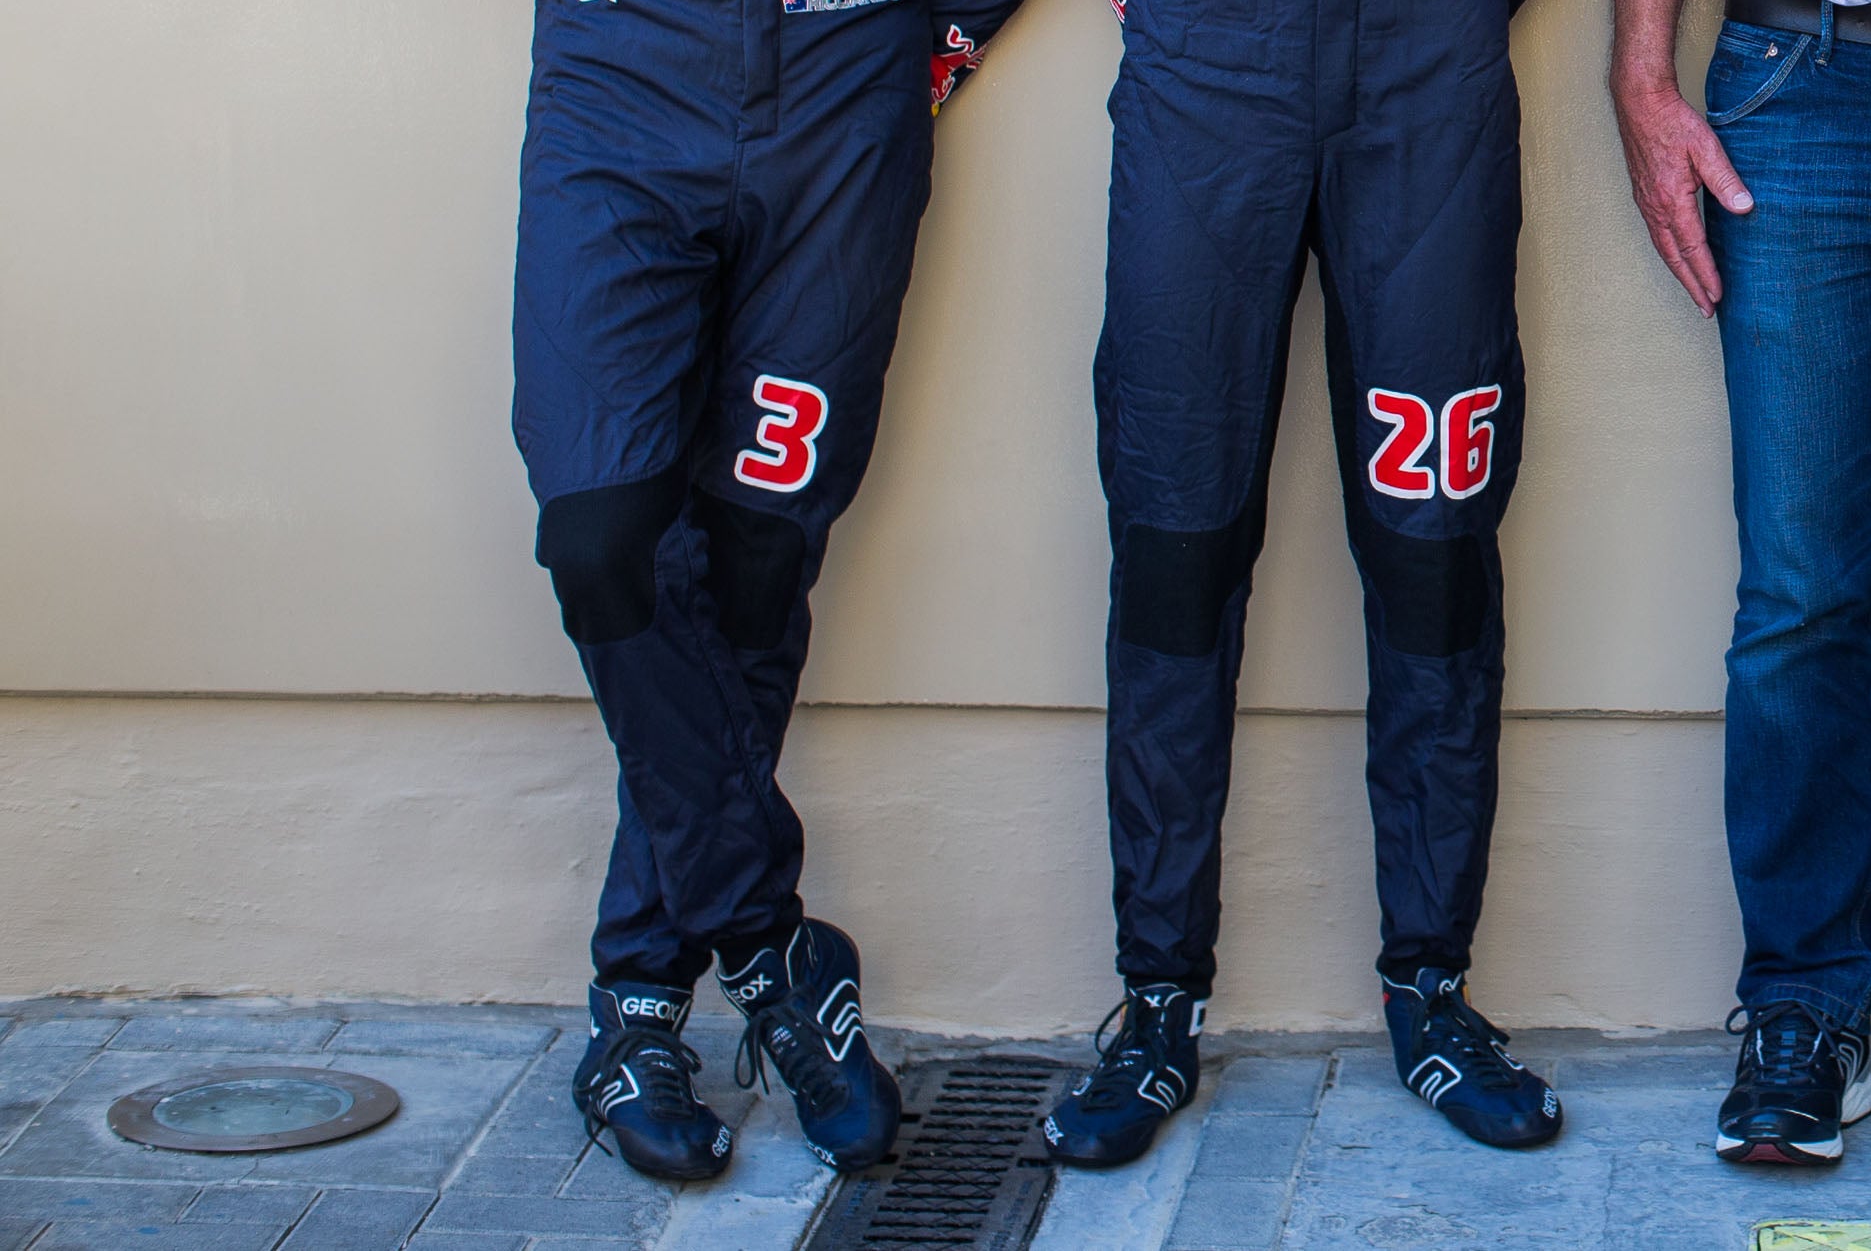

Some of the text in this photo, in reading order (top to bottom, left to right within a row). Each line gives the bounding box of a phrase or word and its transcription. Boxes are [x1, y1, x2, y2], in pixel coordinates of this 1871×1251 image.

[734, 374, 829, 493] 3
[1368, 383, 1502, 500] 26
[622, 997, 680, 1021] GEOX
